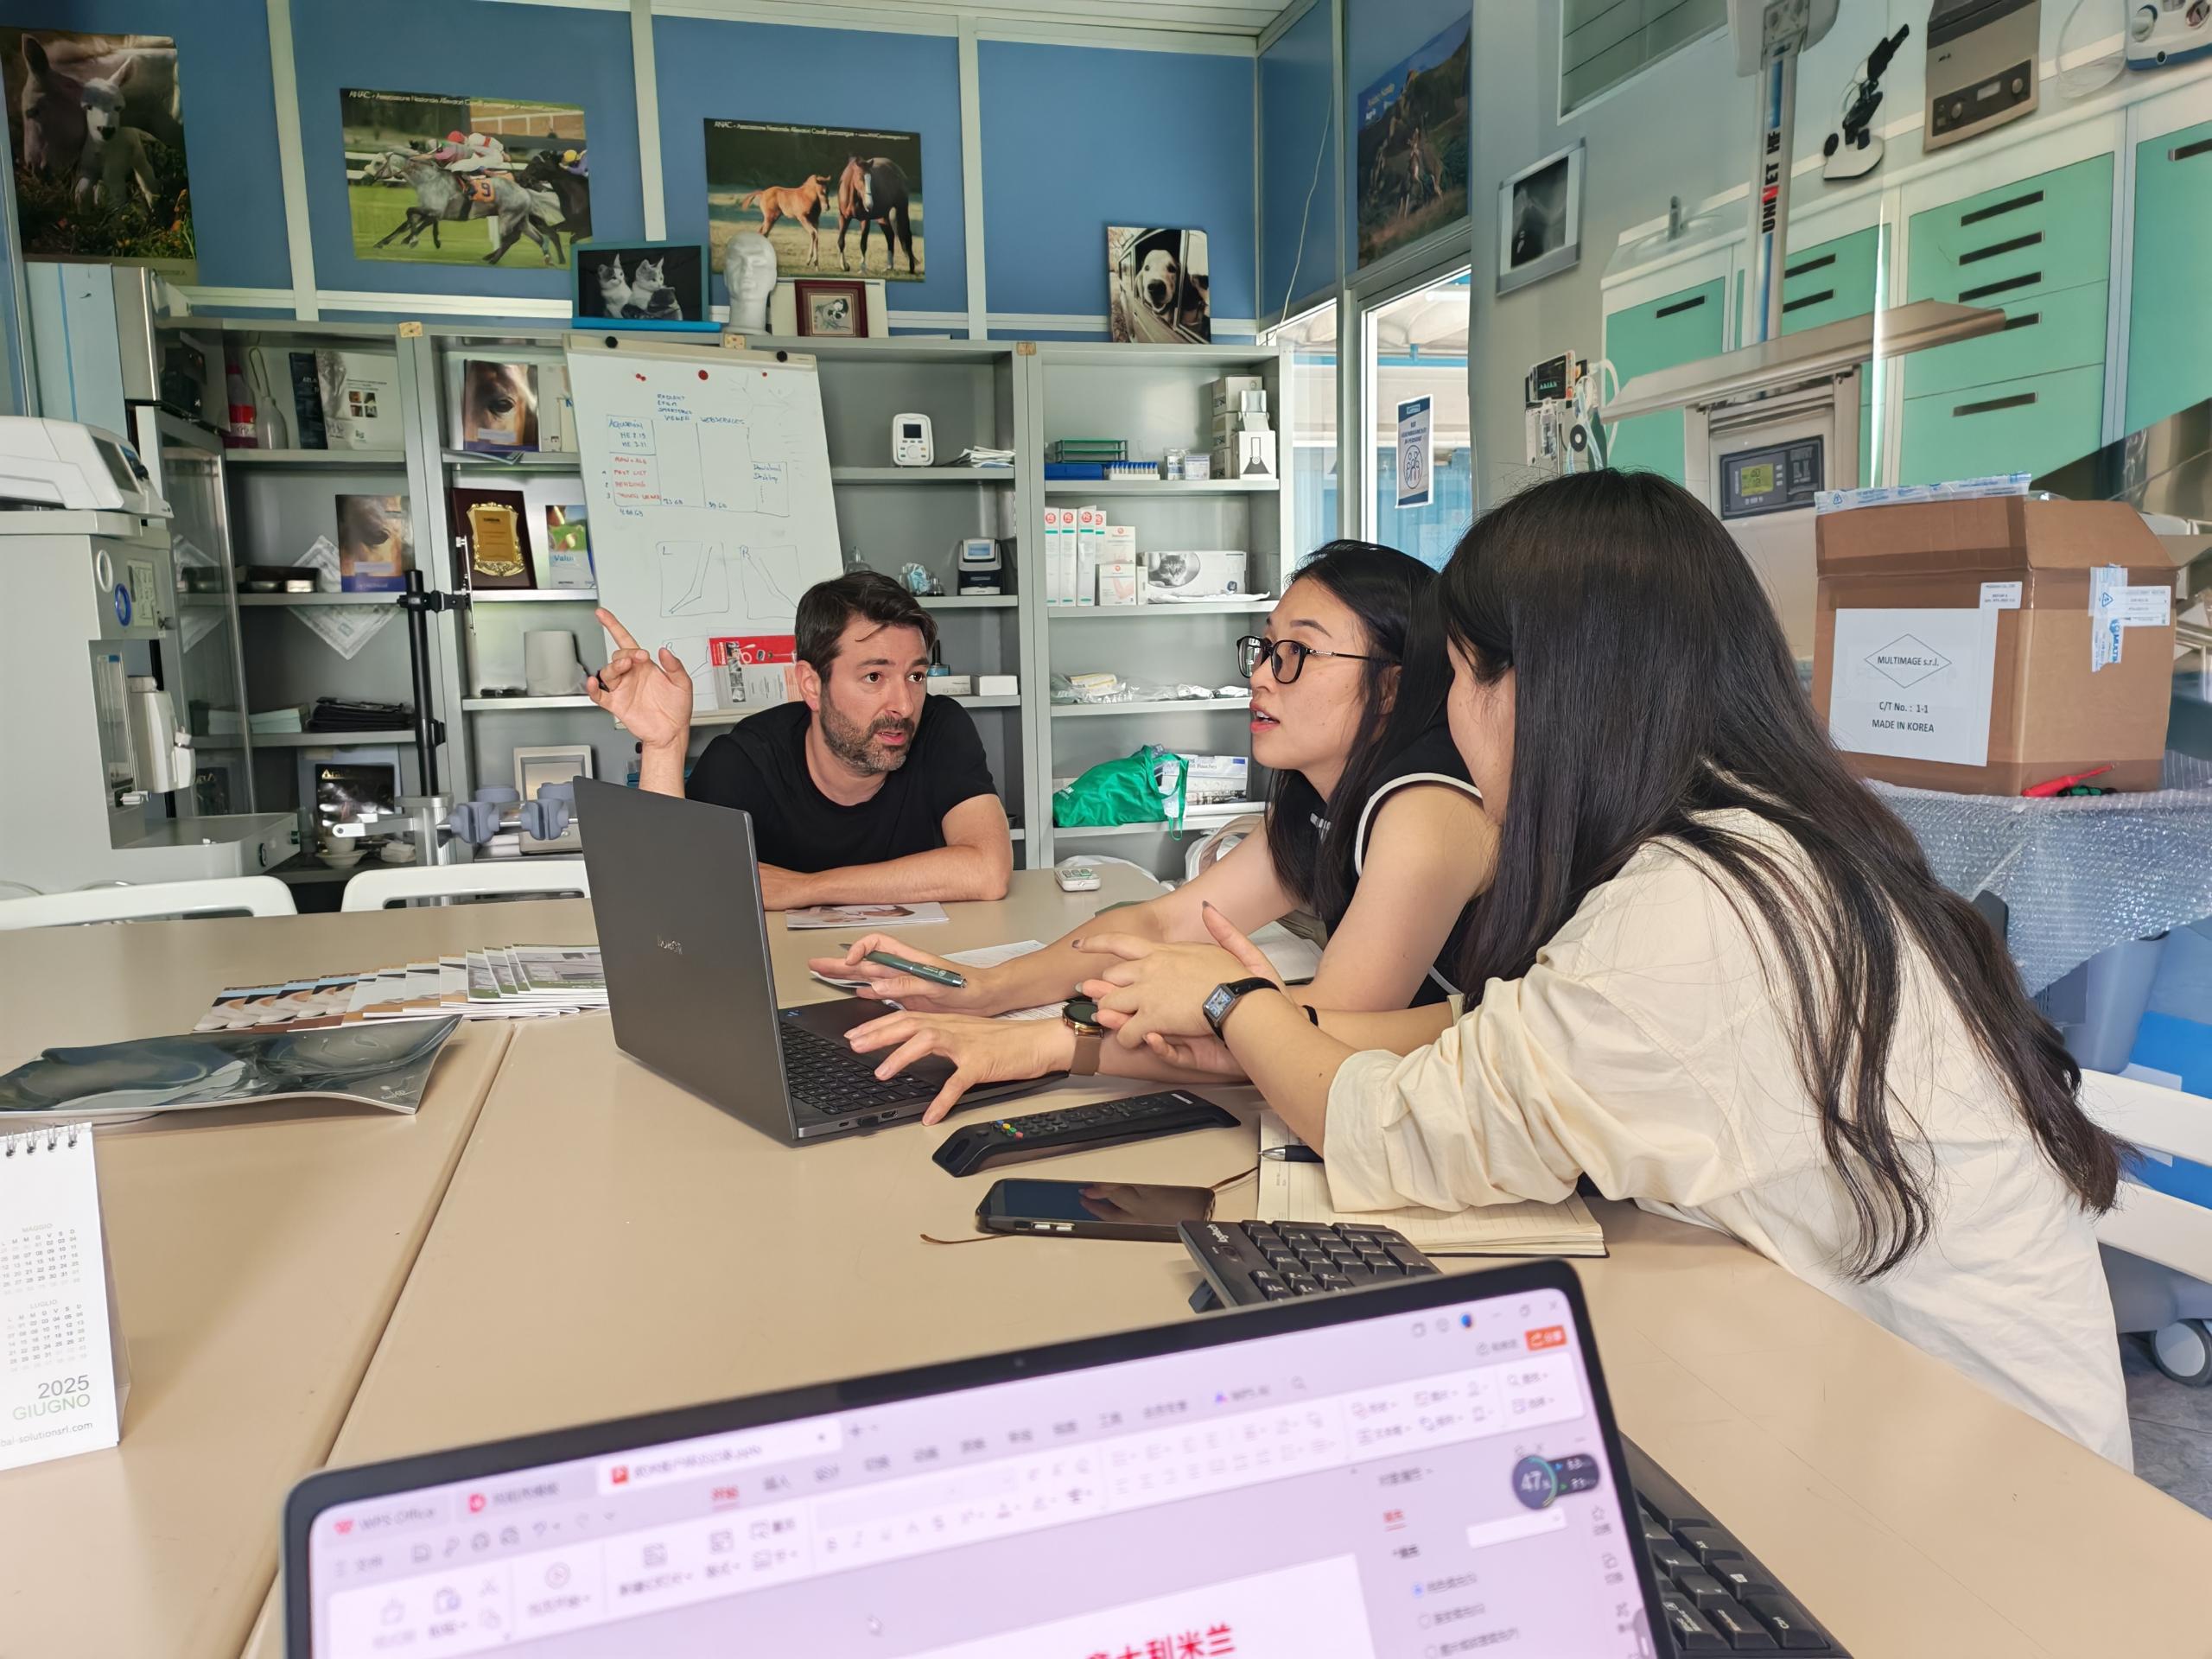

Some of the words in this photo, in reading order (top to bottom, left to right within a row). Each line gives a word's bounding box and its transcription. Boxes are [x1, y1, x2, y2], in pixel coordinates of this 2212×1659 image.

[481, 182, 491, 197] 9
[1762, 162, 1779, 234] UNIVET
[1877, 655, 1922, 666] MULTIMAGE
[1923, 658, 1940, 667] s.r.l.
[1879, 701, 1892, 712] C/T
[1894, 702, 1908, 712] No.
[1916, 704, 1929, 714] 1-1
[1872, 719, 1895, 729] MADE
[1897, 721, 1905, 730] IN
[1907, 722, 1935, 733] KOREA
[22, 1223, 52, 1232] MAGGIO
[29, 1299, 58, 1310] LUGLIO
[38, 1374, 90, 1399] 2025
[12, 1393, 91, 1421] GIUGNO
[1085, 1620, 1236, 1659] 利米兰
